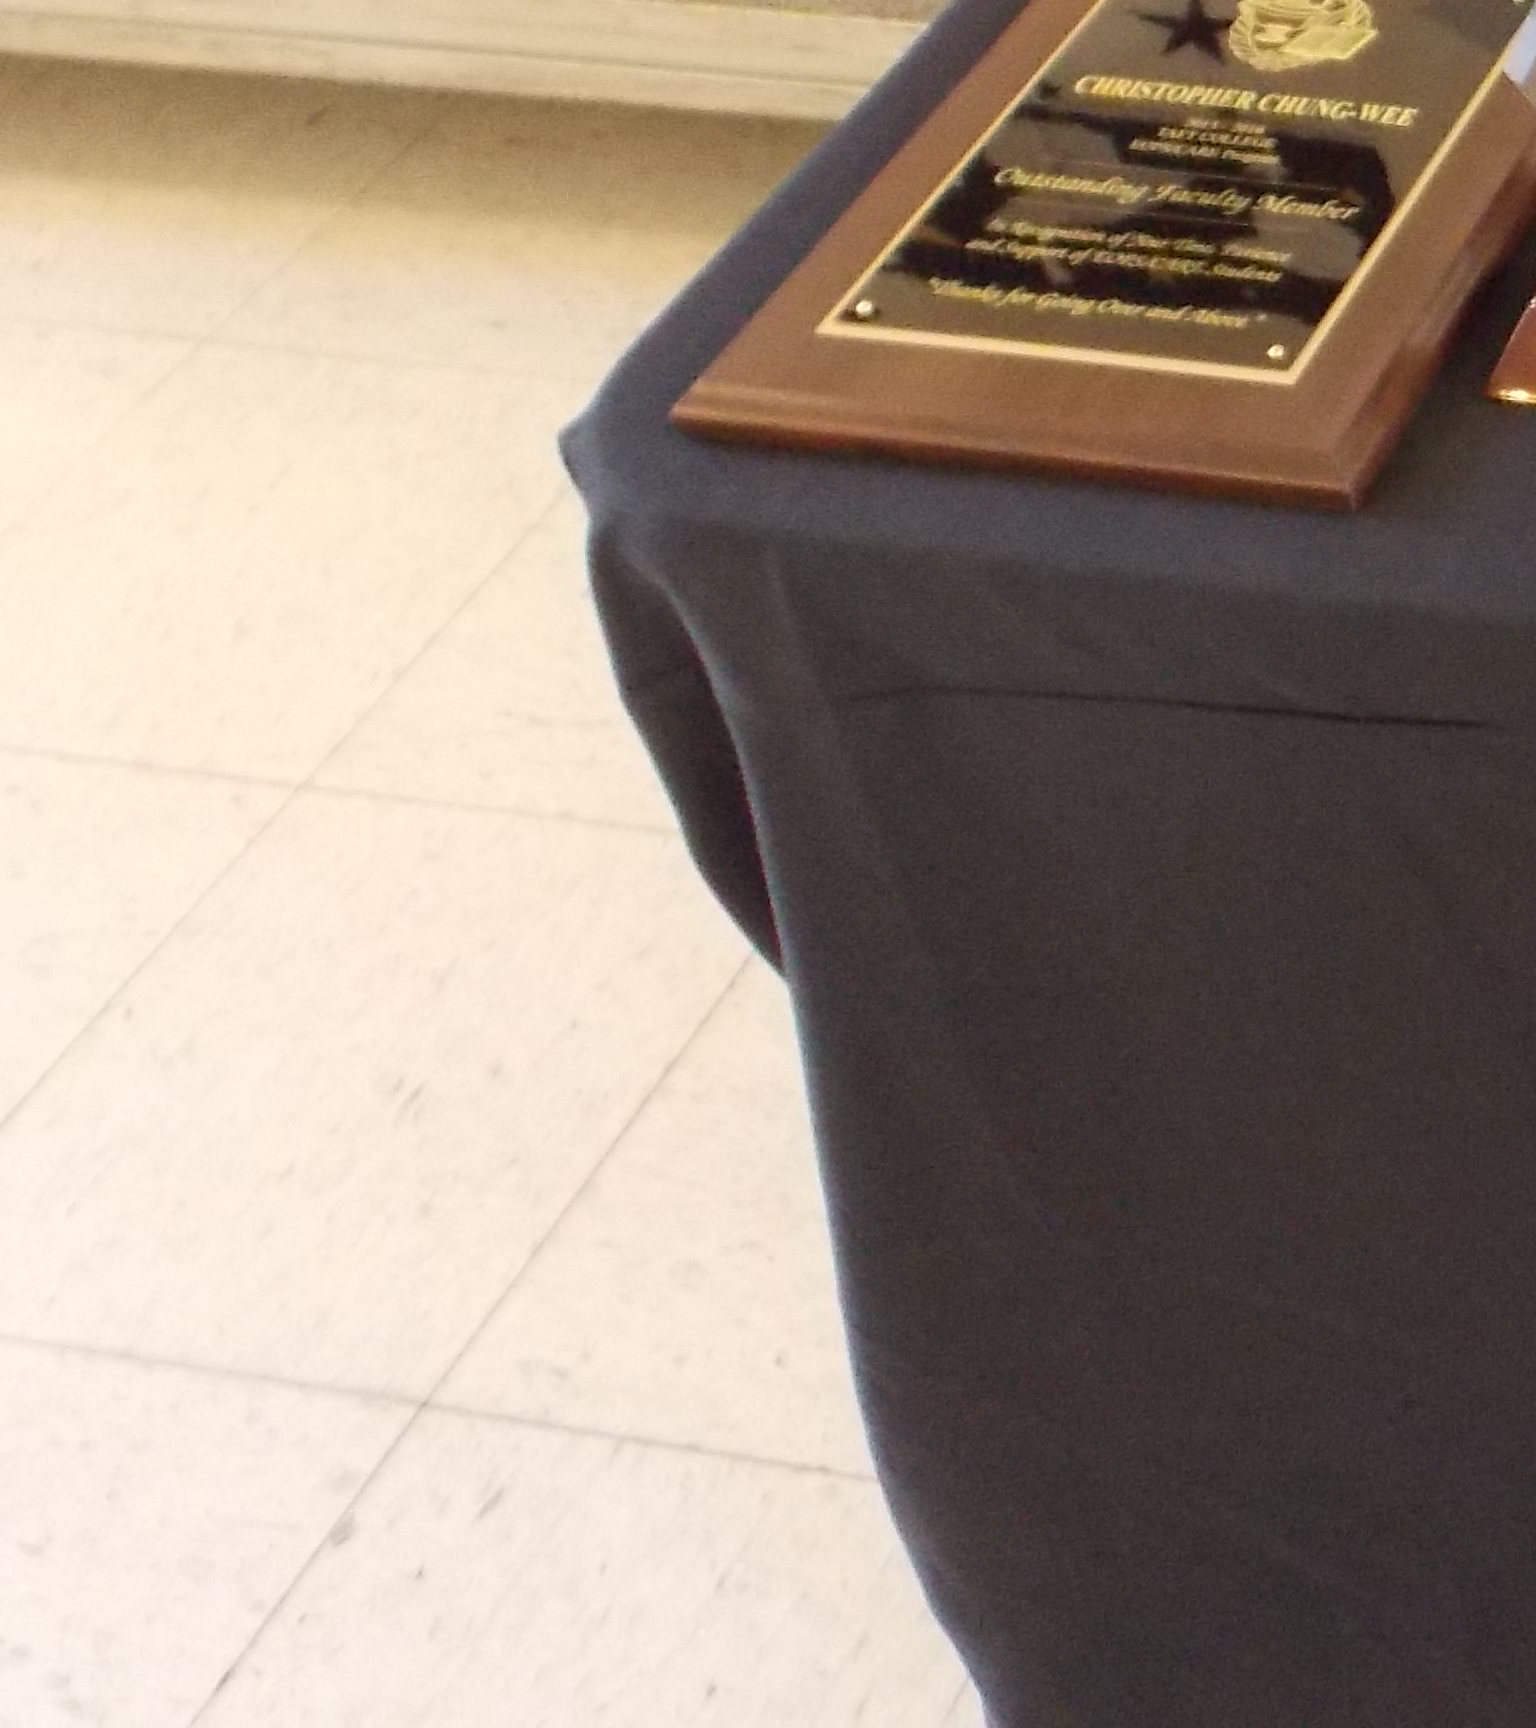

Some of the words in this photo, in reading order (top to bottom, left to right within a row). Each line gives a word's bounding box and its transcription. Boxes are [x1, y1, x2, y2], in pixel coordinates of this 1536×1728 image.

[1074, 73, 1260, 110] CHRISTOPHER
[1260, 94, 1419, 127] CHUNG-WEE
[994, 168, 1150, 204] Outstanding
[1148, 184, 1252, 215] Faculty
[1250, 195, 1361, 221] Member
